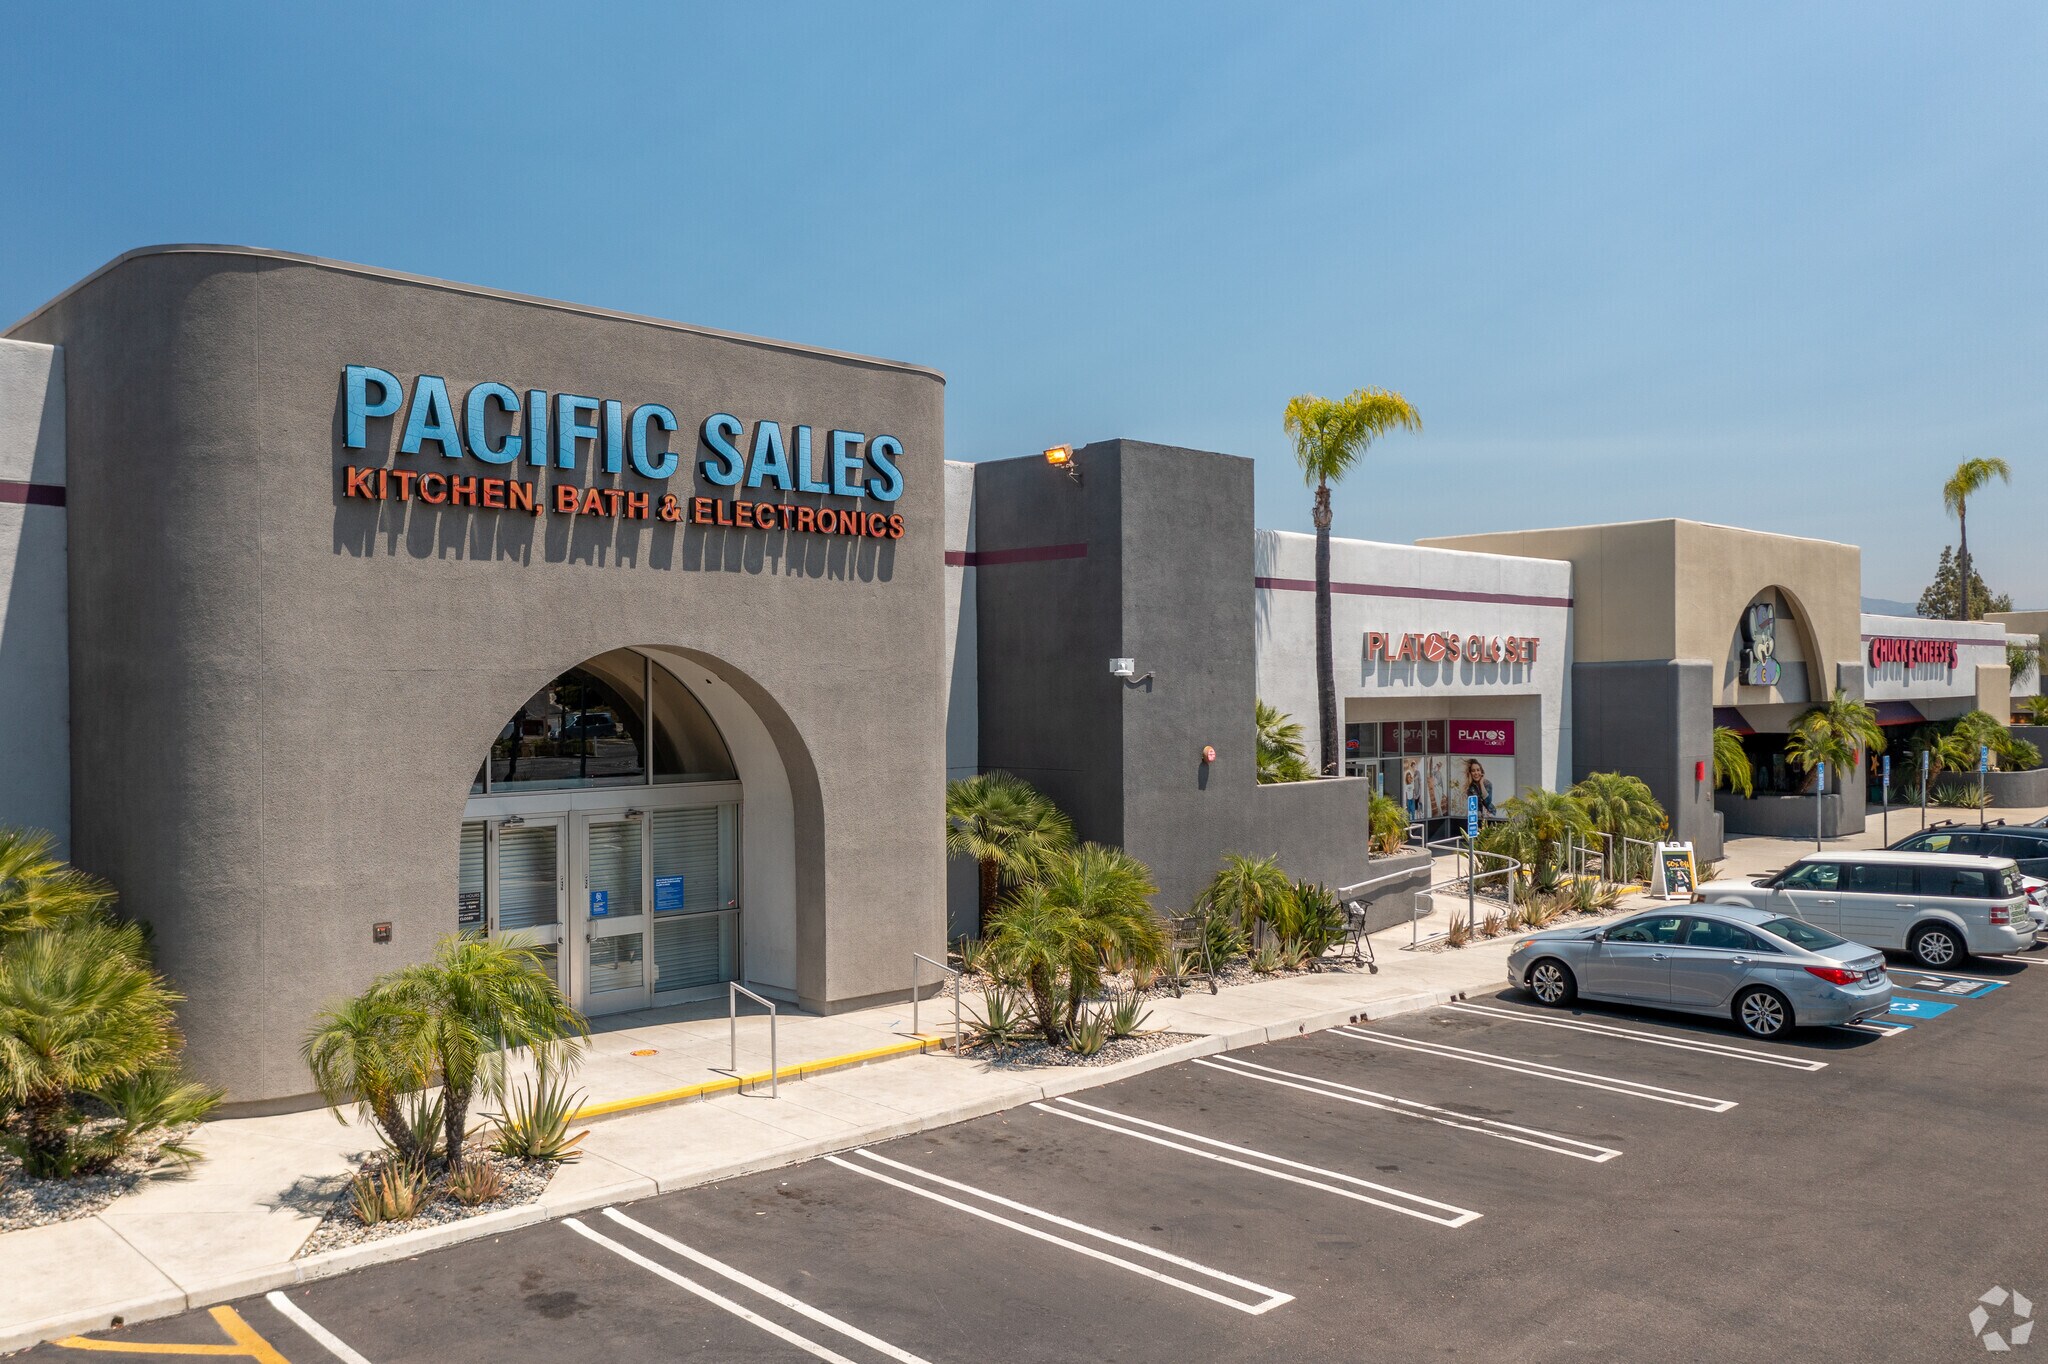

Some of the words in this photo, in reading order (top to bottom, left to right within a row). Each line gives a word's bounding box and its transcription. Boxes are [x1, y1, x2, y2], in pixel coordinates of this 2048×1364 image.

[342, 364, 680, 480] PACIFIC
[699, 412, 905, 502] SALES
[343, 464, 545, 517] KITCHEN,
[552, 483, 650, 519] BATH
[656, 493, 684, 522] &
[689, 496, 906, 540] ELECTRONICS
[1364, 630, 1461, 663] PLATO'S
[1464, 634, 1541, 664] CLOSET
[1869, 637, 1908, 668] CHUCK
[1458, 729, 1506, 740] PLATO'S
